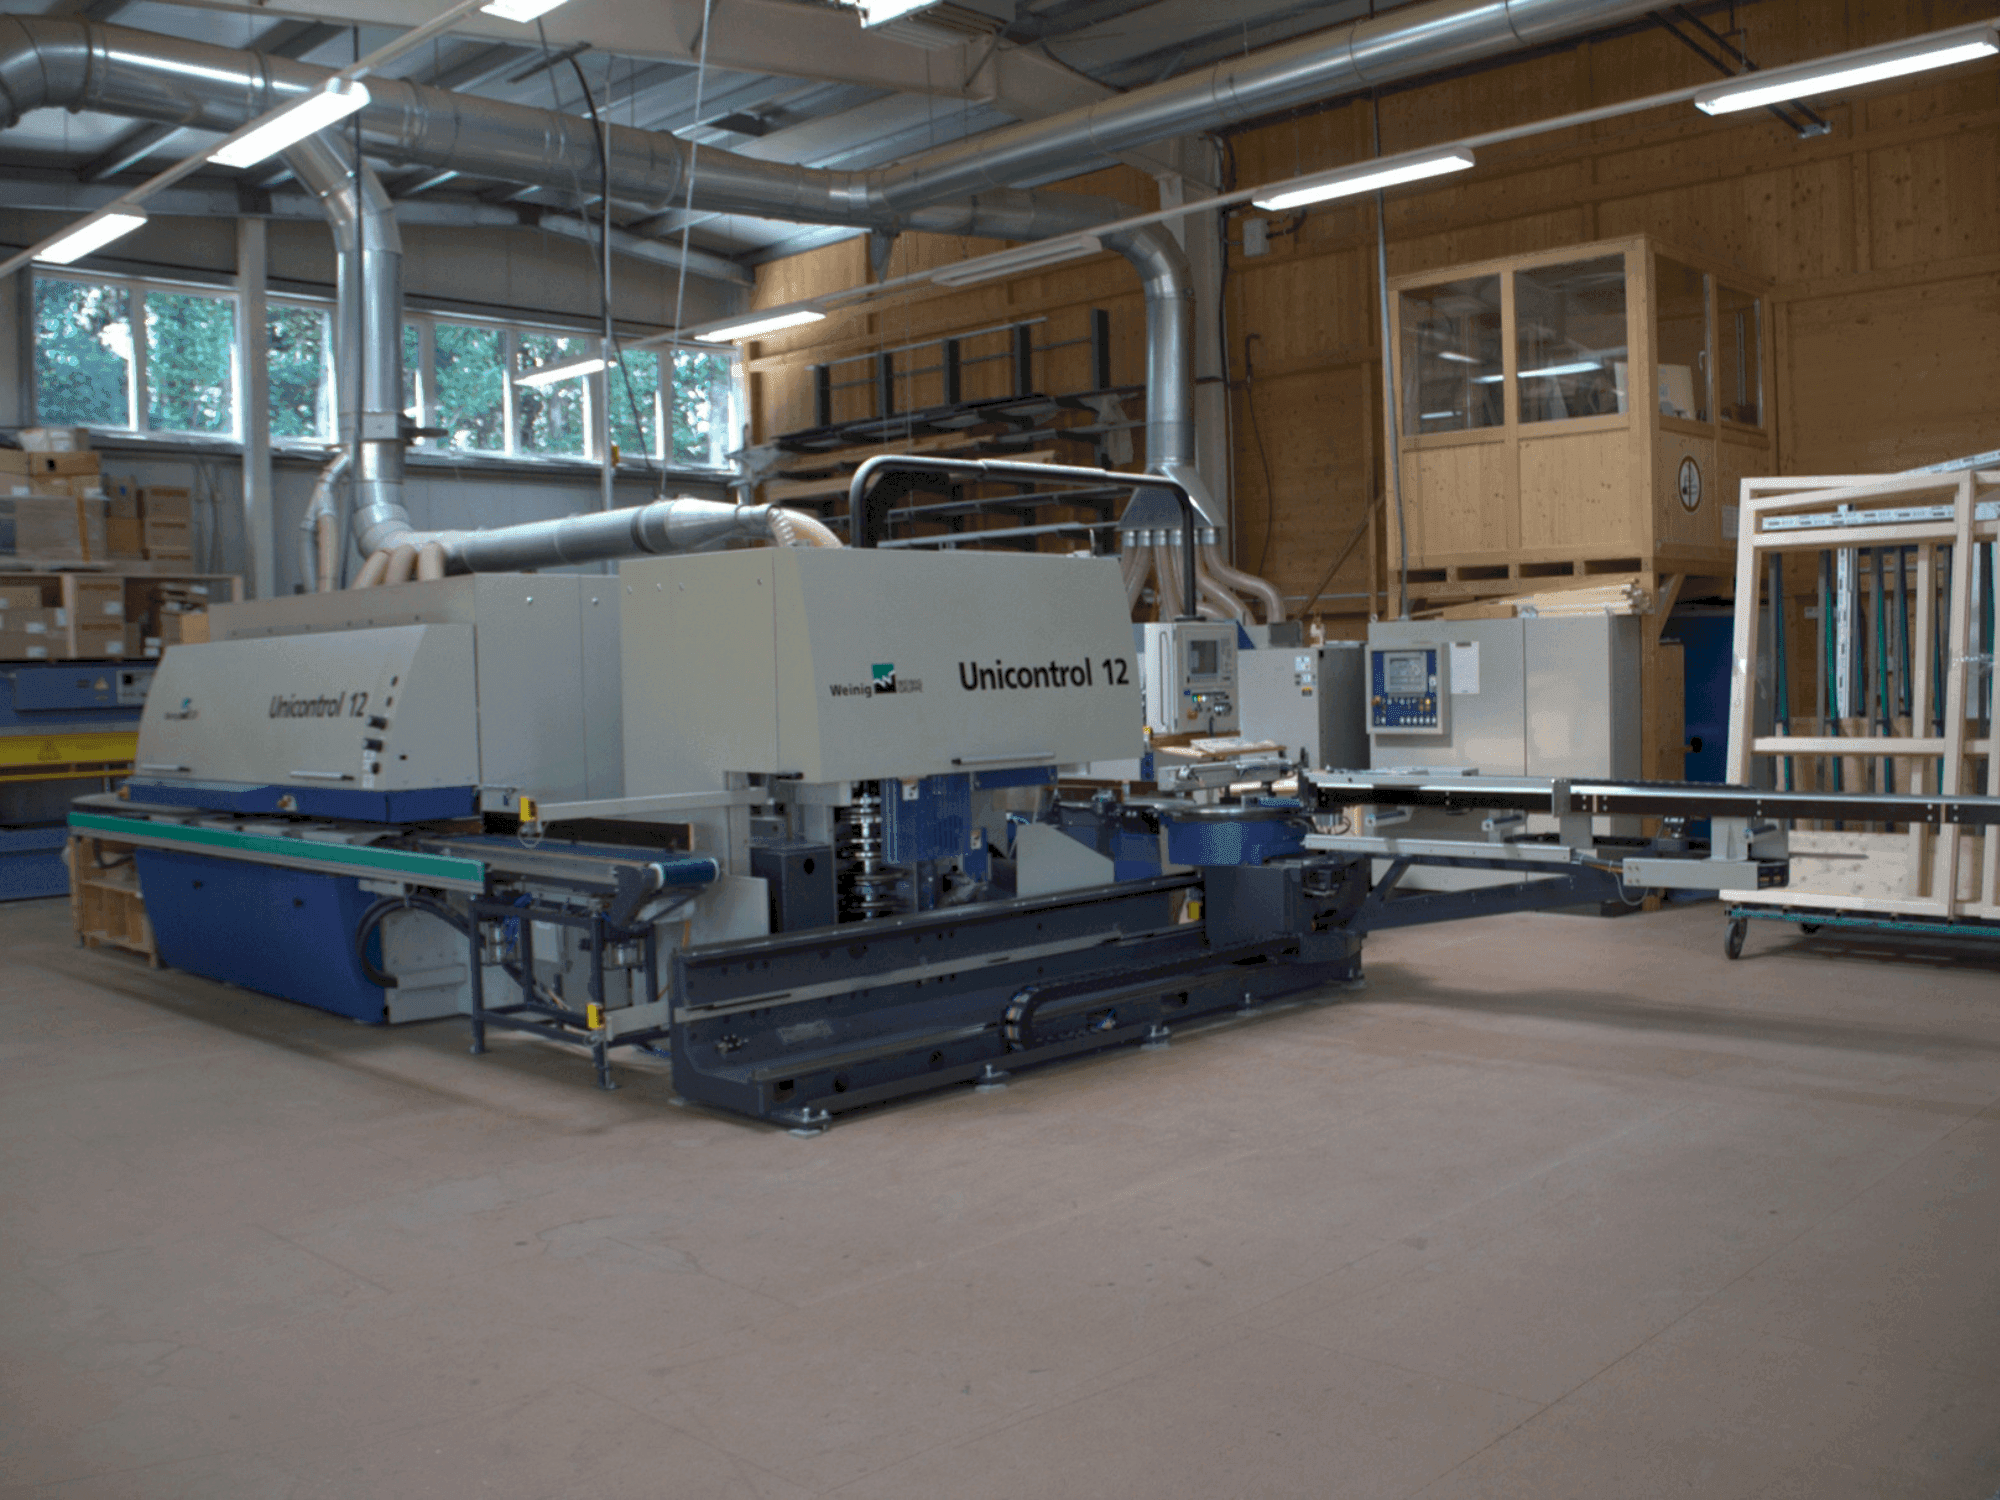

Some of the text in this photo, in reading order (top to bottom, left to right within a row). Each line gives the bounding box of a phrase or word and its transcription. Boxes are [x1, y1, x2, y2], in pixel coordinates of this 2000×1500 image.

[958, 656, 1092, 691] Unicontrol
[1101, 657, 1130, 686] 12
[268, 690, 369, 719] Unicontrol 12
[829, 682, 872, 699] Weinig
